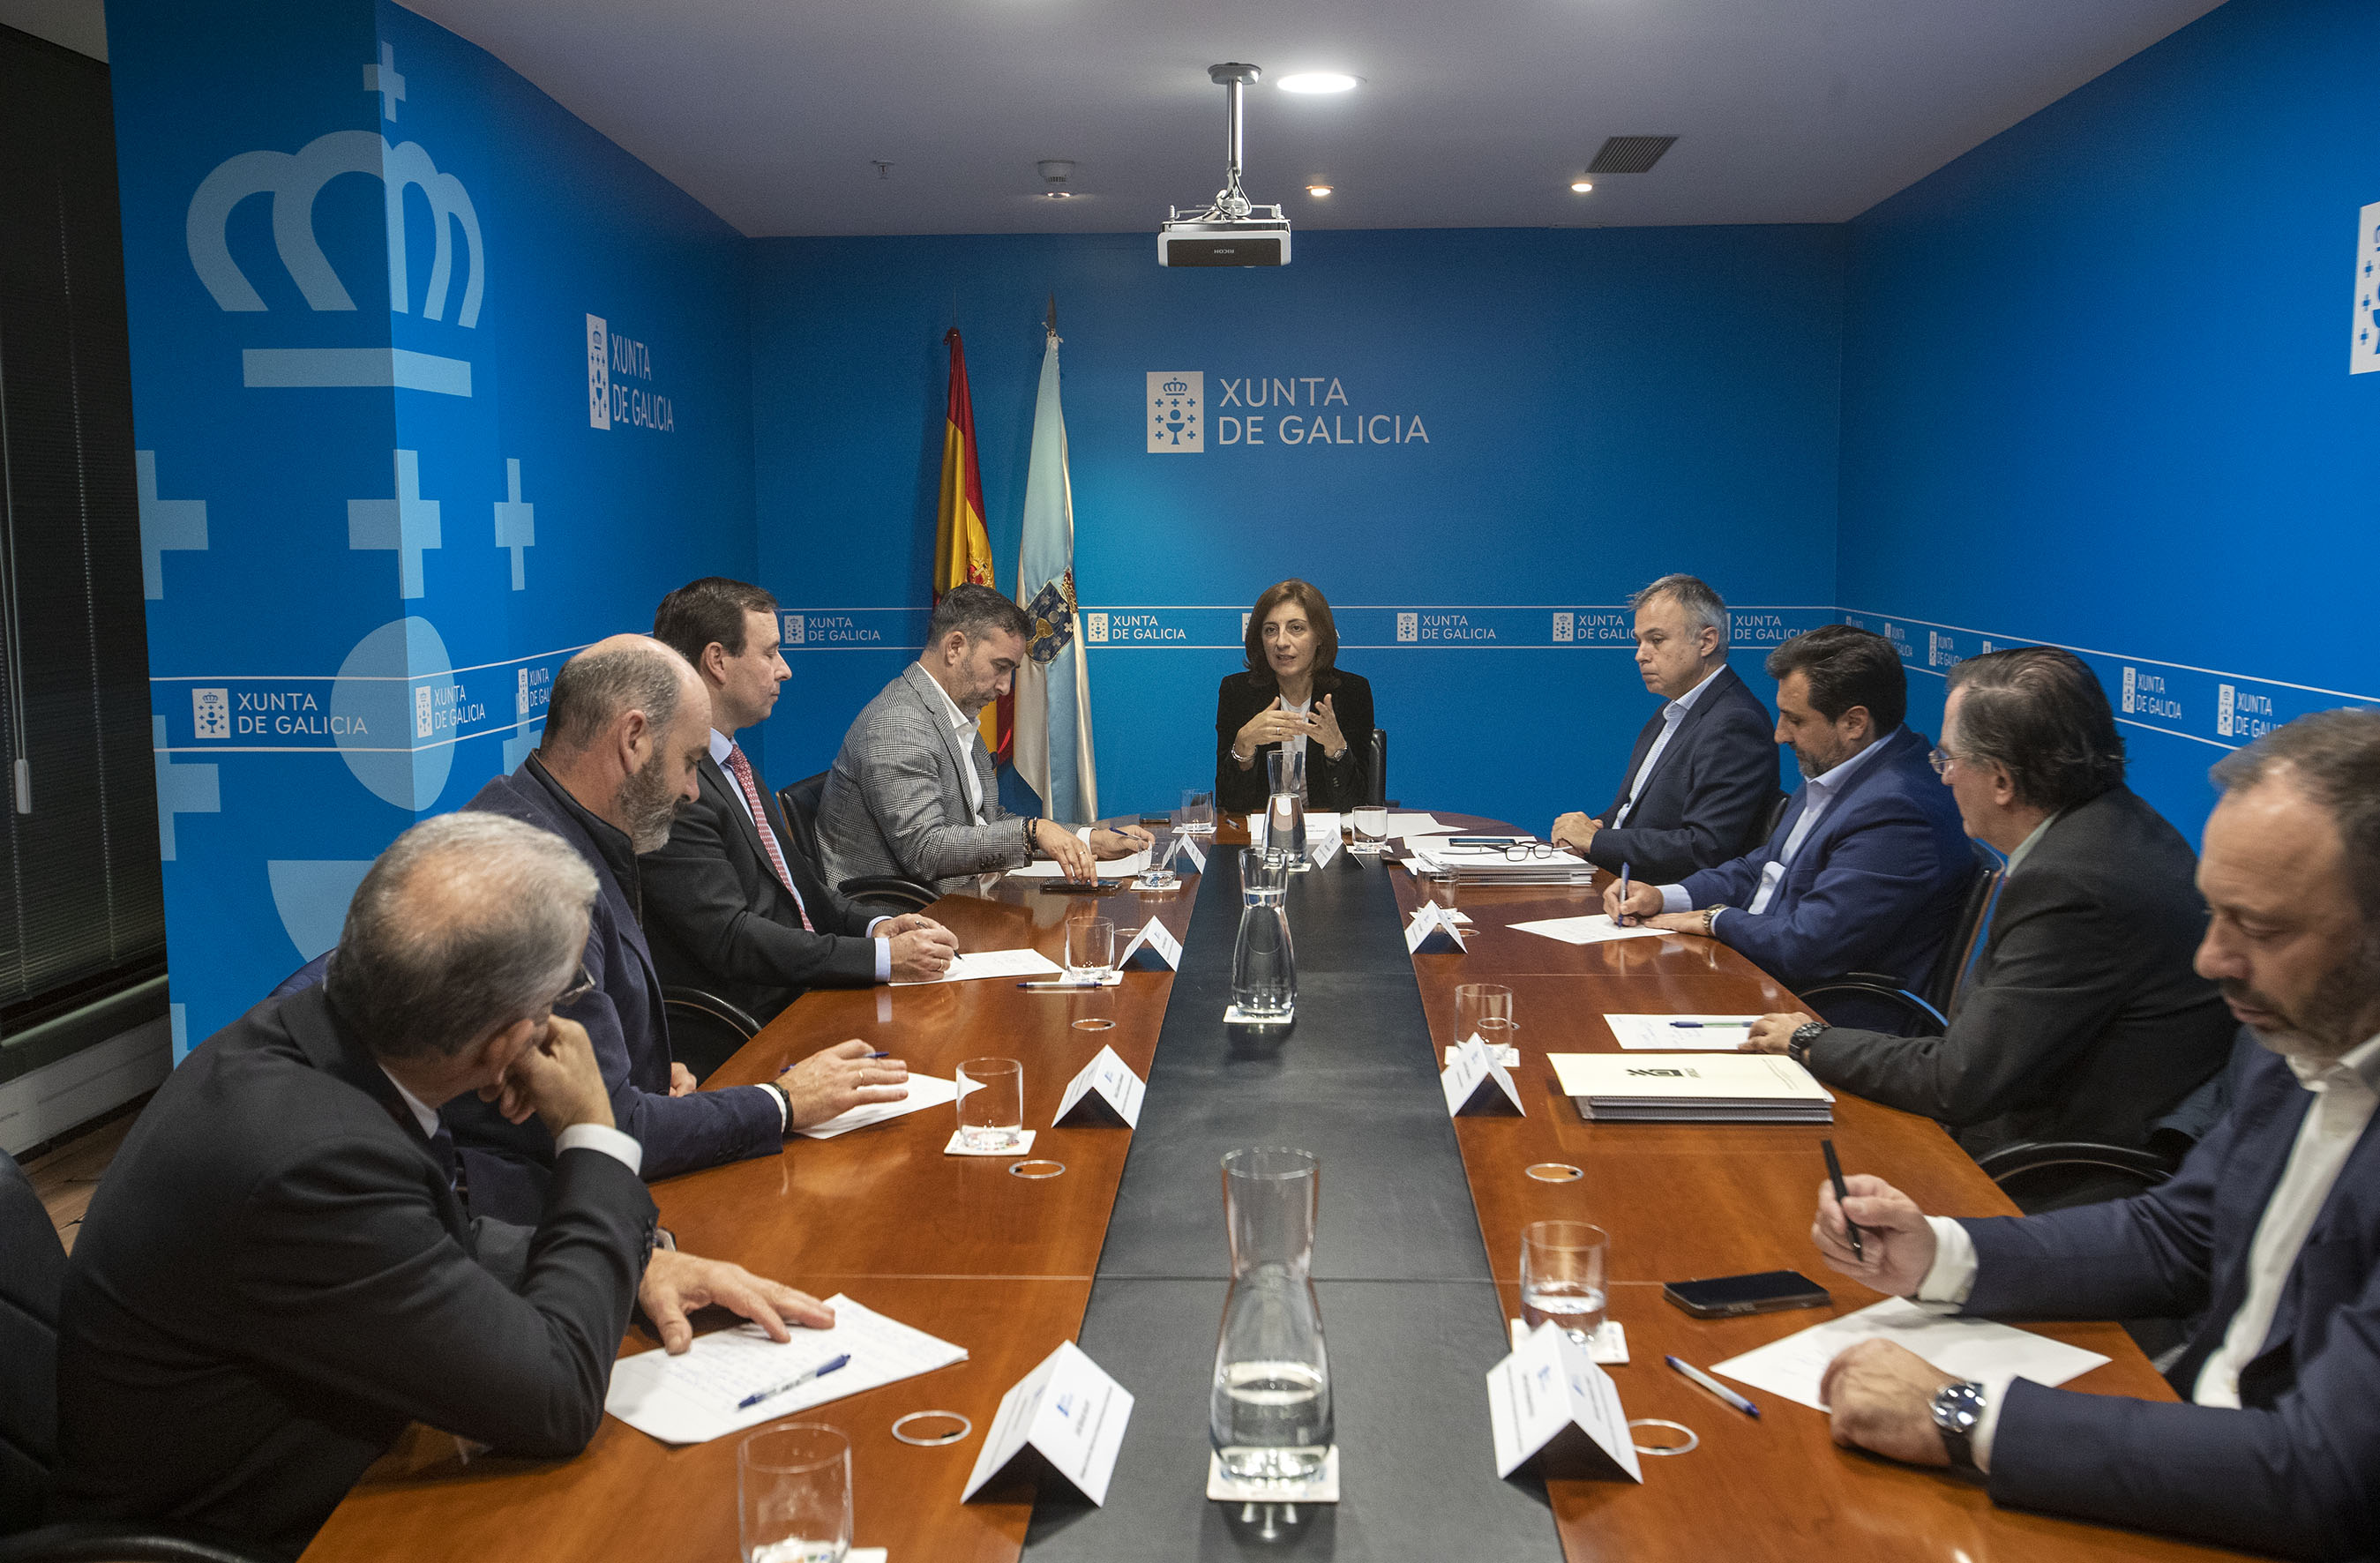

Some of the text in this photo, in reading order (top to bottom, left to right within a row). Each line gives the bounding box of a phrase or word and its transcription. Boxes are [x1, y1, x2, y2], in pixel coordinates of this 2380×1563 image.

[610, 333, 652, 381] XUNTA
[1218, 378, 1349, 408] XUNTA
[612, 384, 674, 432] DE GALICIA
[1218, 415, 1430, 445] DE GALICIA
[808, 617, 853, 629] XUNTA
[1112, 615, 1158, 626] XUNTA
[1422, 615, 1469, 626] XUNTA
[1578, 615, 1624, 626] XUNTA
[1735, 615, 1782, 626] XUNTA
[808, 630, 881, 641] DE GALICIA
[1112, 628, 1186, 639] DE GALICIA
[1422, 628, 1497, 639] DE GALICIA
[1577, 628, 1635, 639] DE GALIC
[1734, 628, 1752, 639] DE
[529, 668, 550, 687] XUNTA
[2137, 673, 2166, 694] XUNTA
[237, 692, 318, 711] XUNTA
[434, 684, 467, 707] XUNTA
[529, 689, 538, 707] DE
[2236, 692, 2273, 716] XUNTA
[435, 703, 486, 730] DE GALICIA
[2137, 694, 2182, 720] DE GALICIA
[237, 715, 369, 736] DE GALICIA
[2234, 715, 2250, 736] DE
